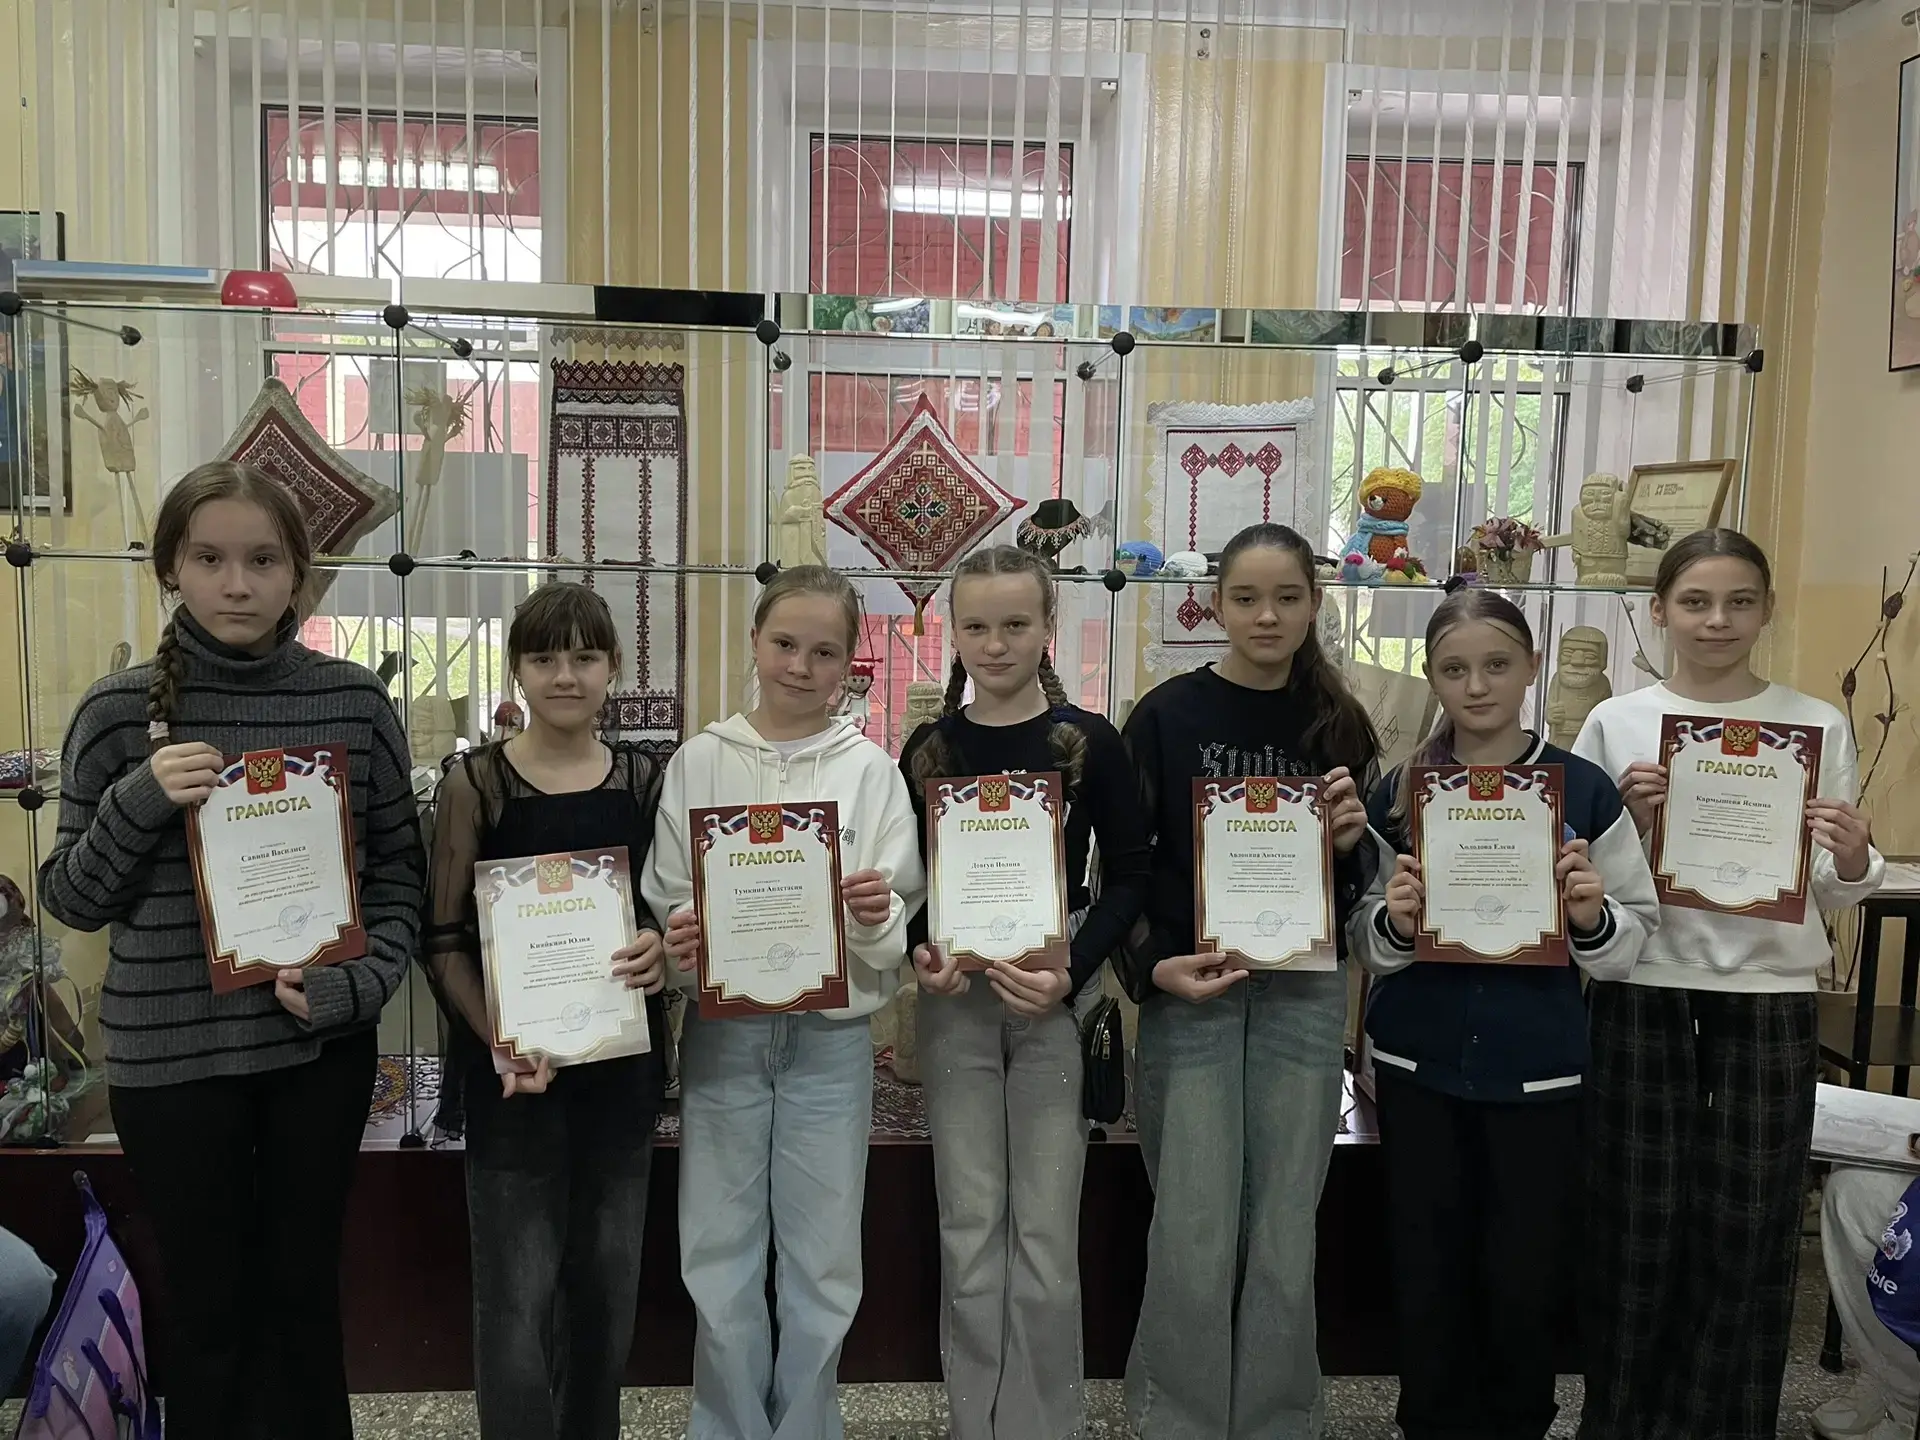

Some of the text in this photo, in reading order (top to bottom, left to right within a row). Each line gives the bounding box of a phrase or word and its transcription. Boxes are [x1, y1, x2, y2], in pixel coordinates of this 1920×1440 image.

[1696, 760, 1778, 779] ГРАМОТА
[226, 796, 312, 822] ГРАМОТА
[1448, 808, 1526, 820] ГРАМОТА
[960, 817, 1030, 832] ГРАМОТА
[1227, 820, 1297, 832] ГРАМОТА
[729, 849, 805, 866] ГРАМОТА
[517, 897, 596, 918] ГРАМОТА
